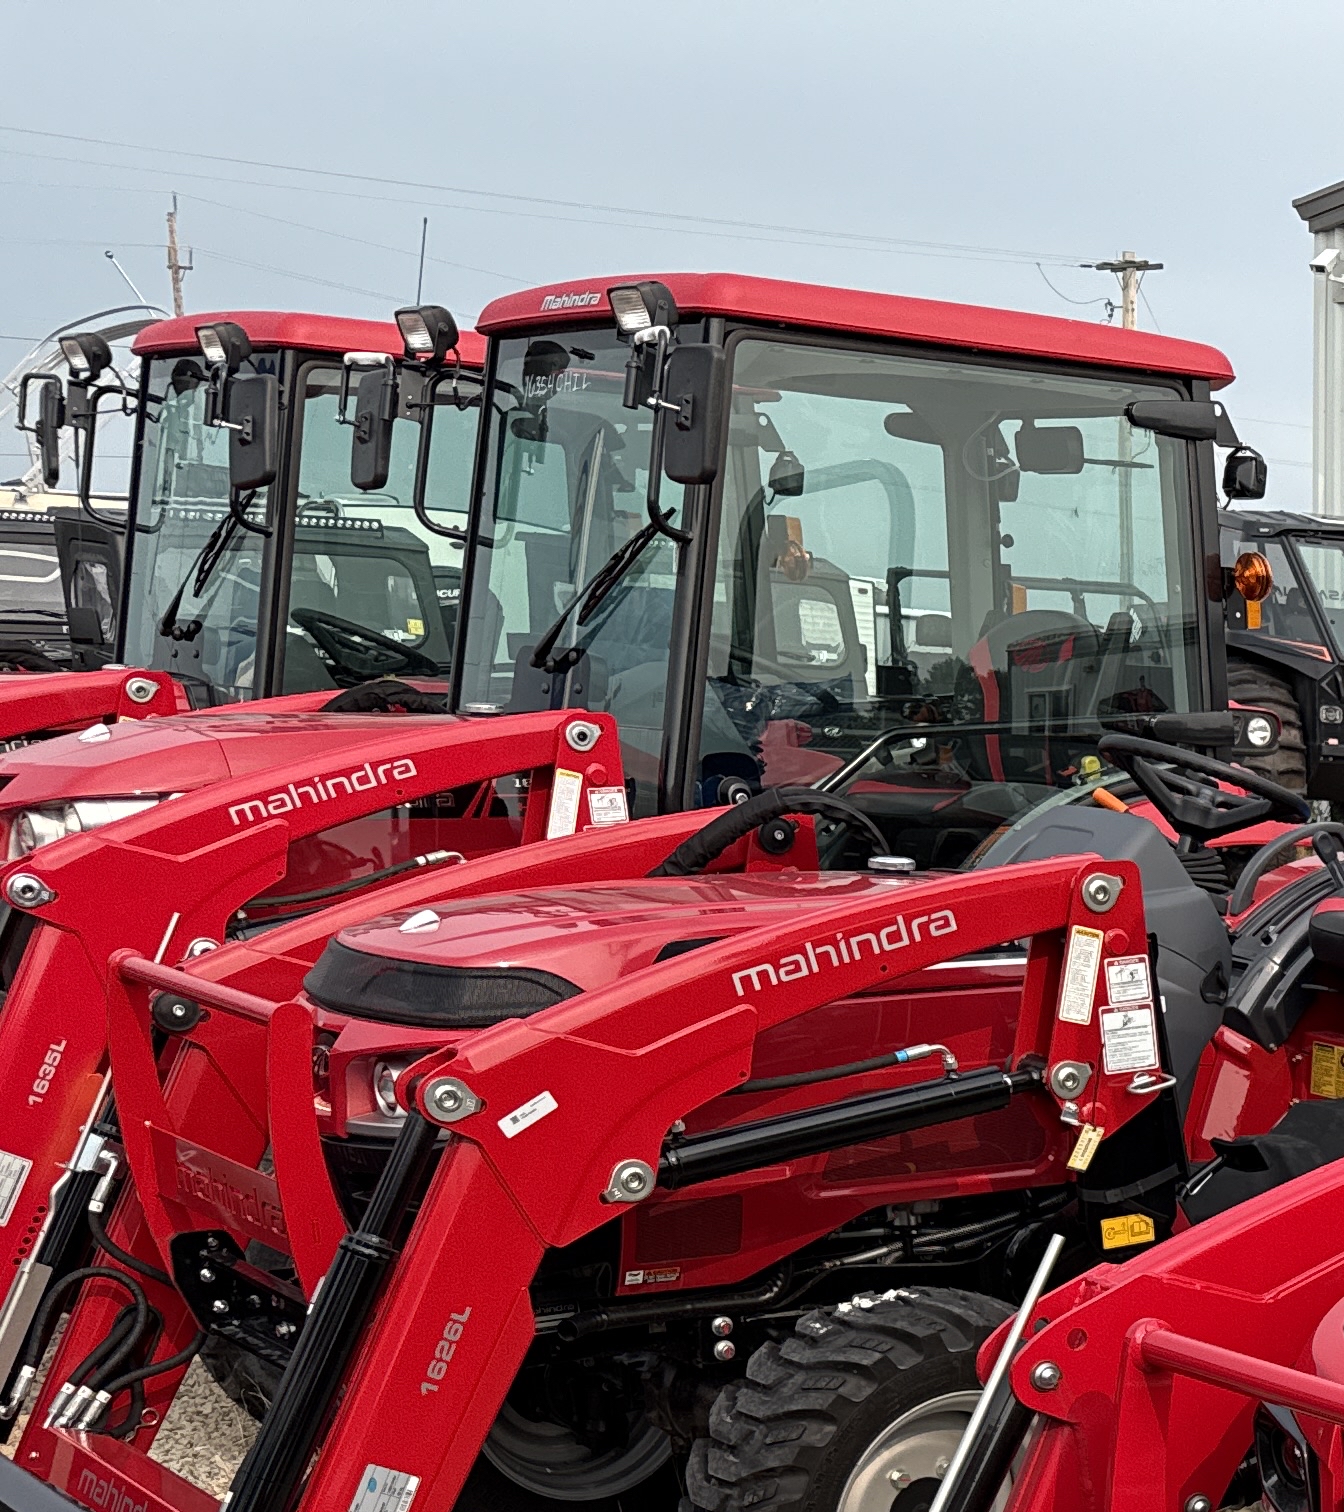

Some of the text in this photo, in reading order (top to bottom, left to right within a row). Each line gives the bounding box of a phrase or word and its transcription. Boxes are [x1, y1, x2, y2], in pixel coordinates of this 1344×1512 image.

[229, 757, 418, 827] mahindra
[732, 908, 957, 997] mahindra
[28, 1039, 67, 1107] 1635L
[421, 1305, 472, 1397] 1626L
